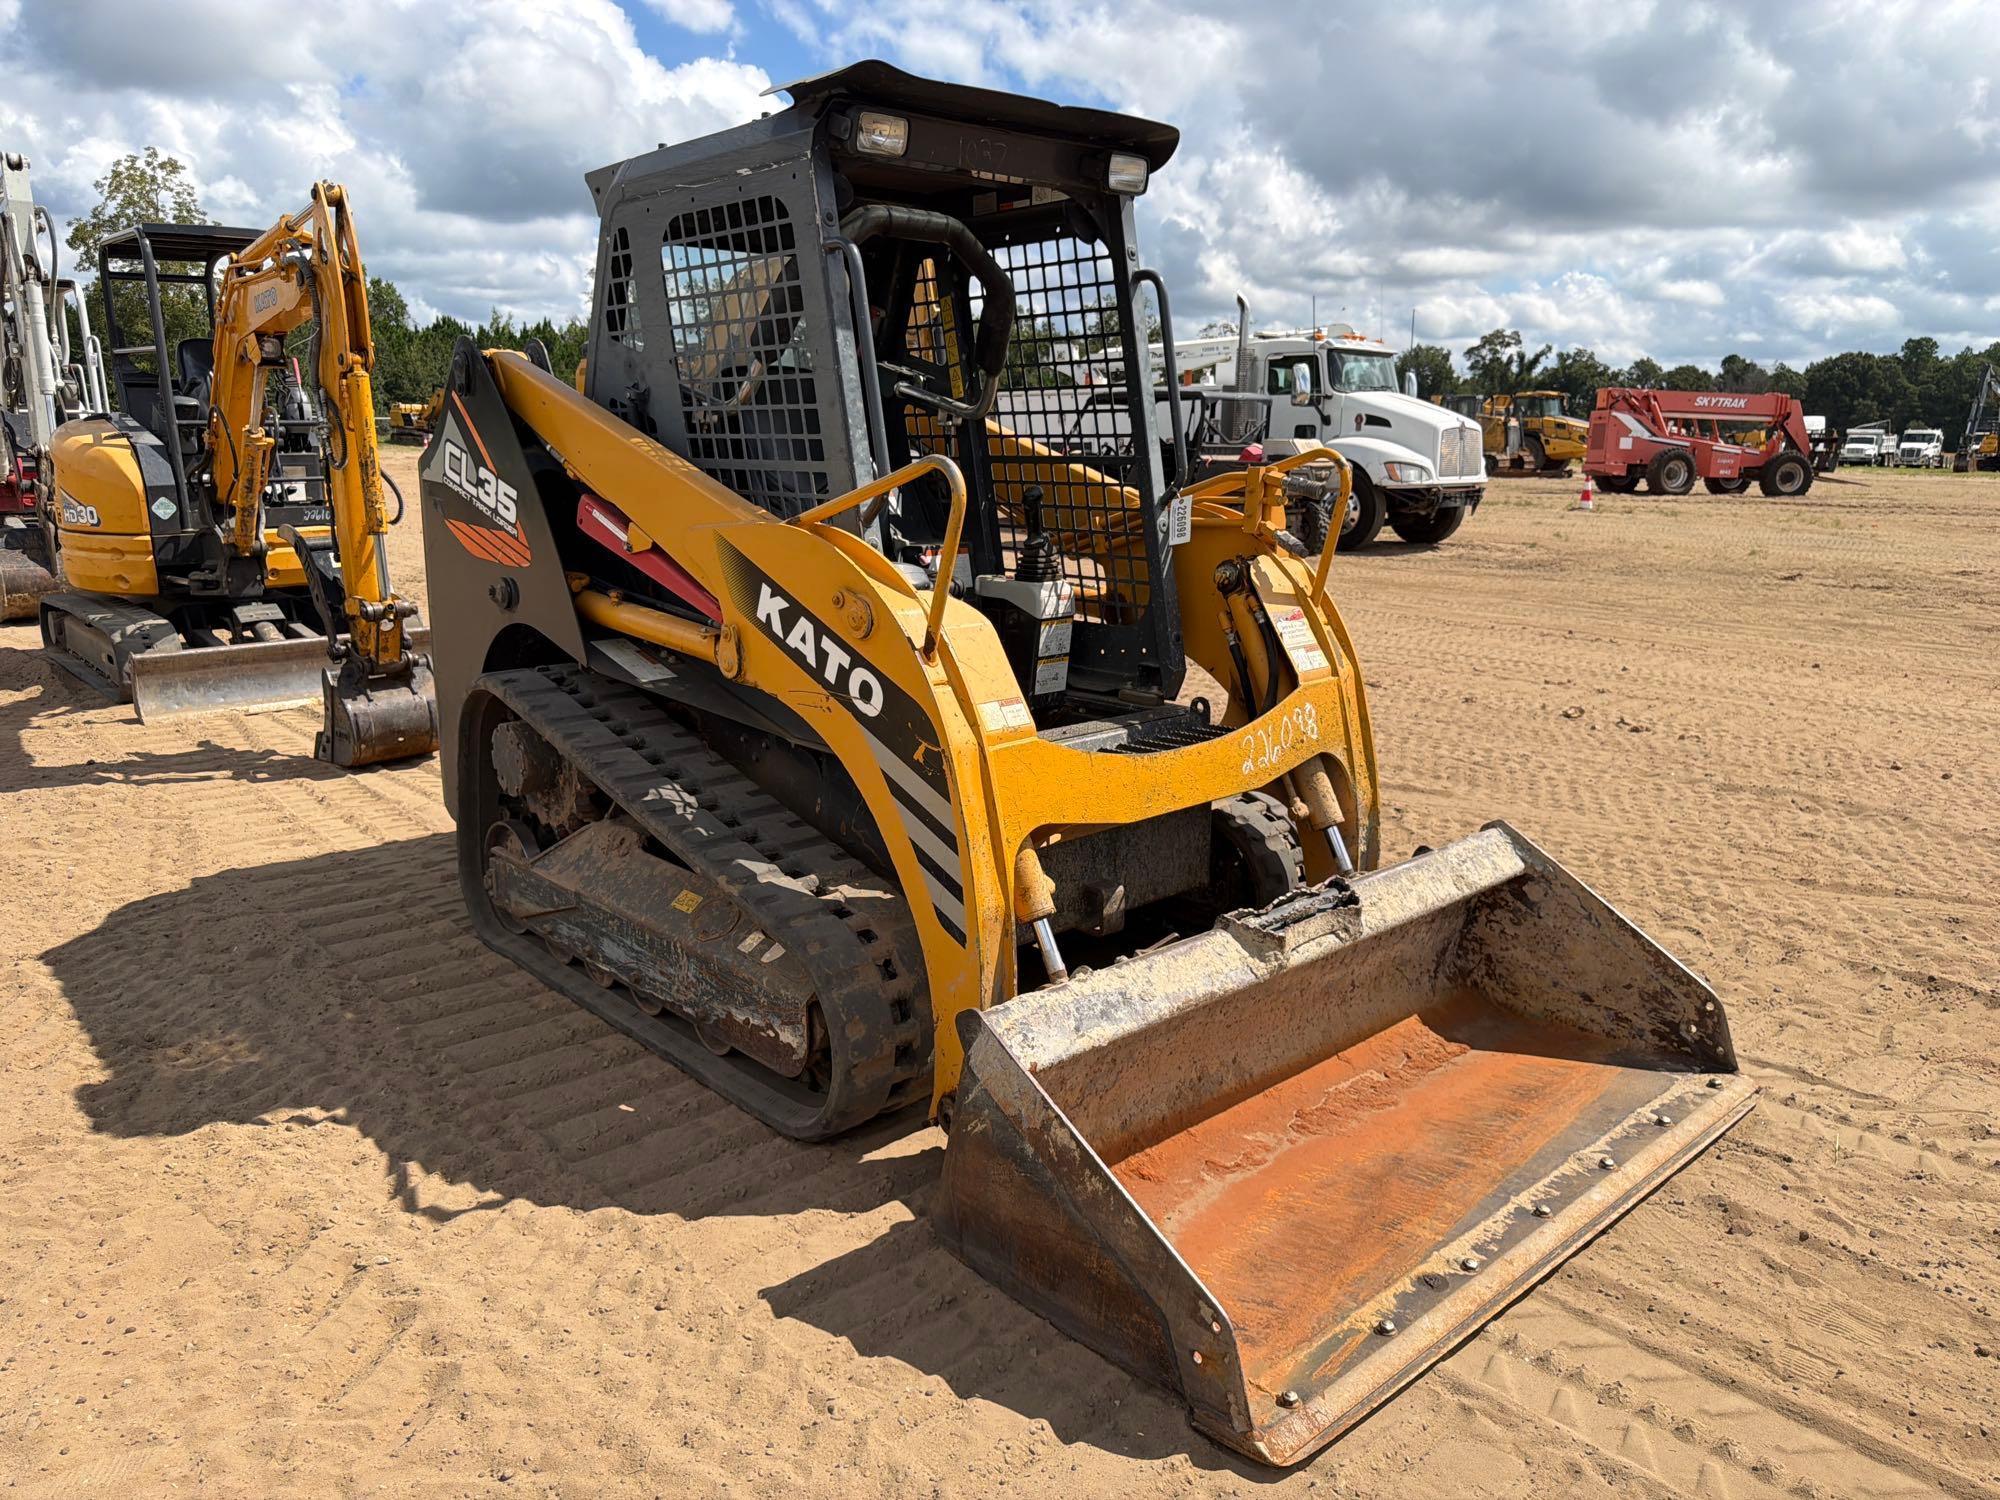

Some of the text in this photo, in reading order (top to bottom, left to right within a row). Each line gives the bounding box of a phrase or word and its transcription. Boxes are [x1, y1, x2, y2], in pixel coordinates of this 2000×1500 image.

[1695, 396, 1748, 408] SKYTRAK
[443, 476, 518, 539] COMPACT TRACK LOADER
[444, 440, 518, 525] CL35
[63, 504, 98, 525] HD30
[1176, 505, 1187, 538] 226098
[756, 582, 884, 718] KATO
[1242, 702, 1319, 775] 226098
